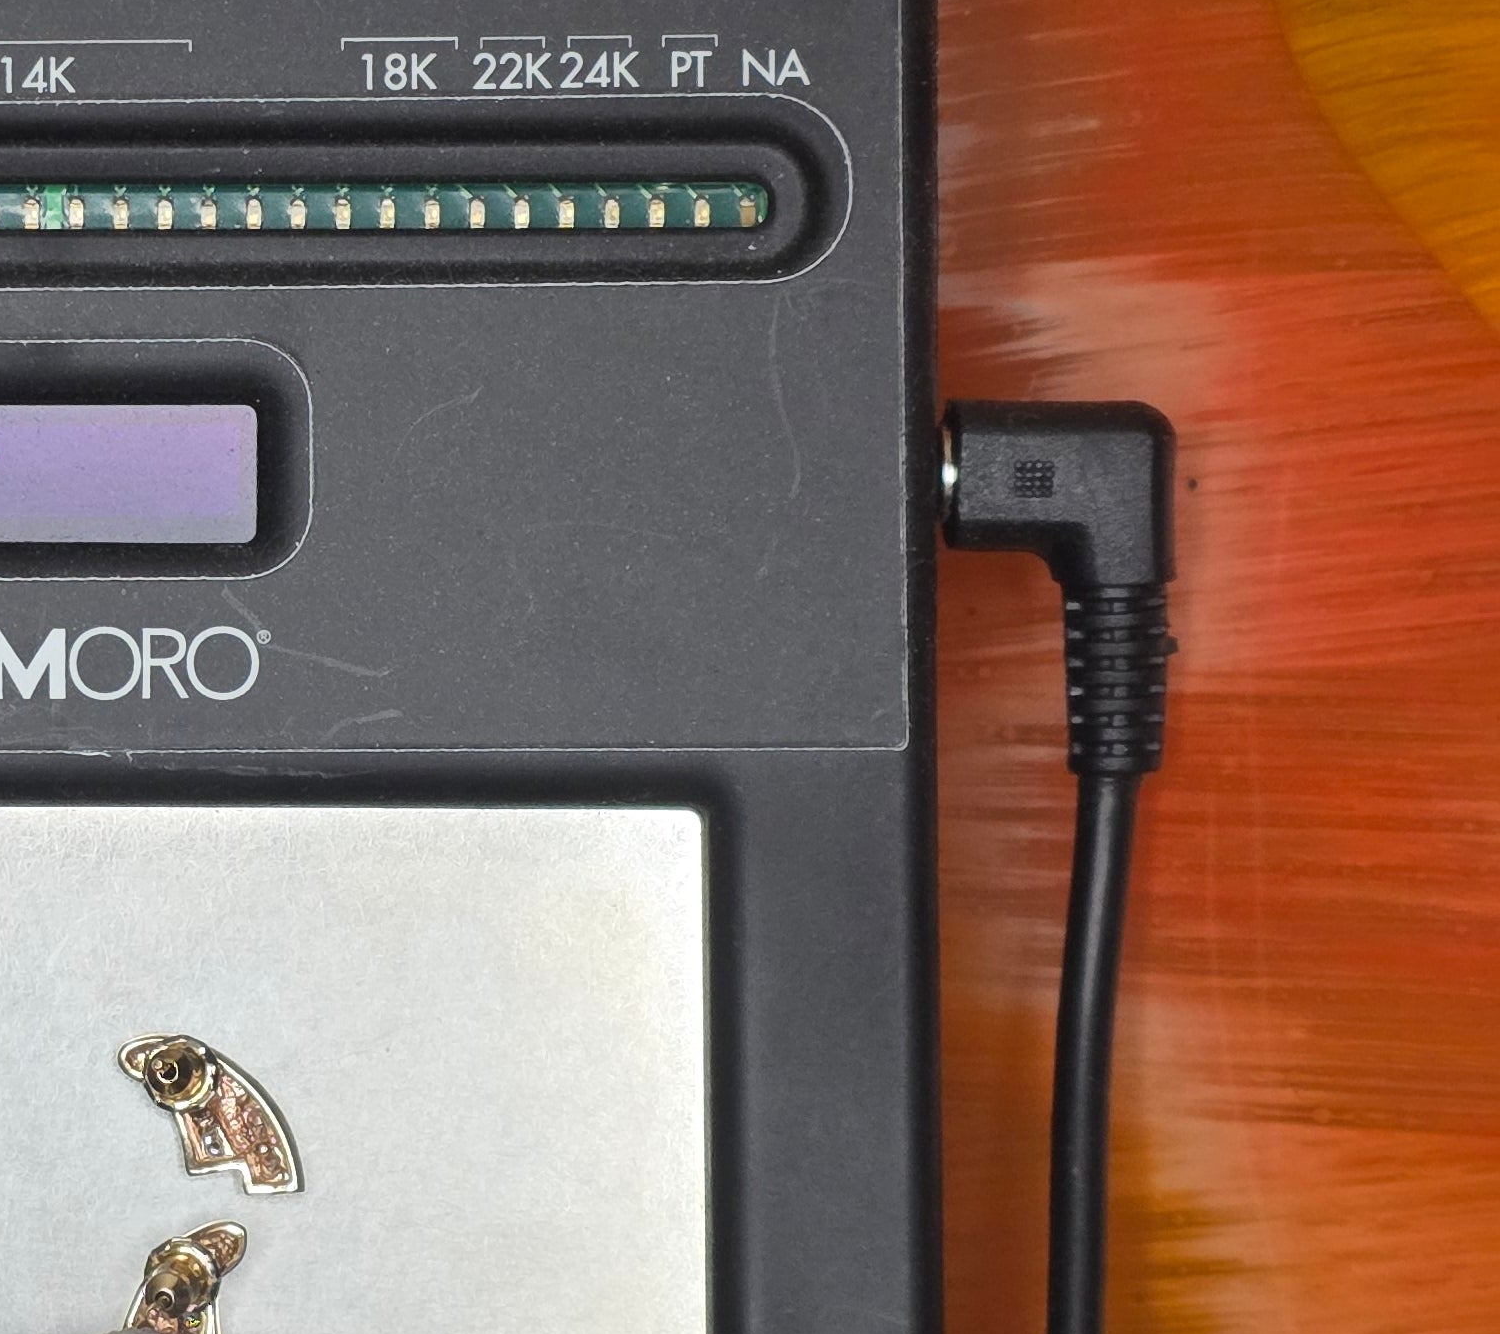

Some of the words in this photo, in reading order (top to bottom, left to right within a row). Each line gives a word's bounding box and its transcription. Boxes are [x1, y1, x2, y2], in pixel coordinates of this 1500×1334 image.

[0, 55, 76, 94] 14K
[361, 52, 438, 91] 18K
[472, 50, 553, 90] 22K
[559, 50, 640, 89] 24K
[670, 50, 713, 88] PT
[742, 48, 811, 87] NA
